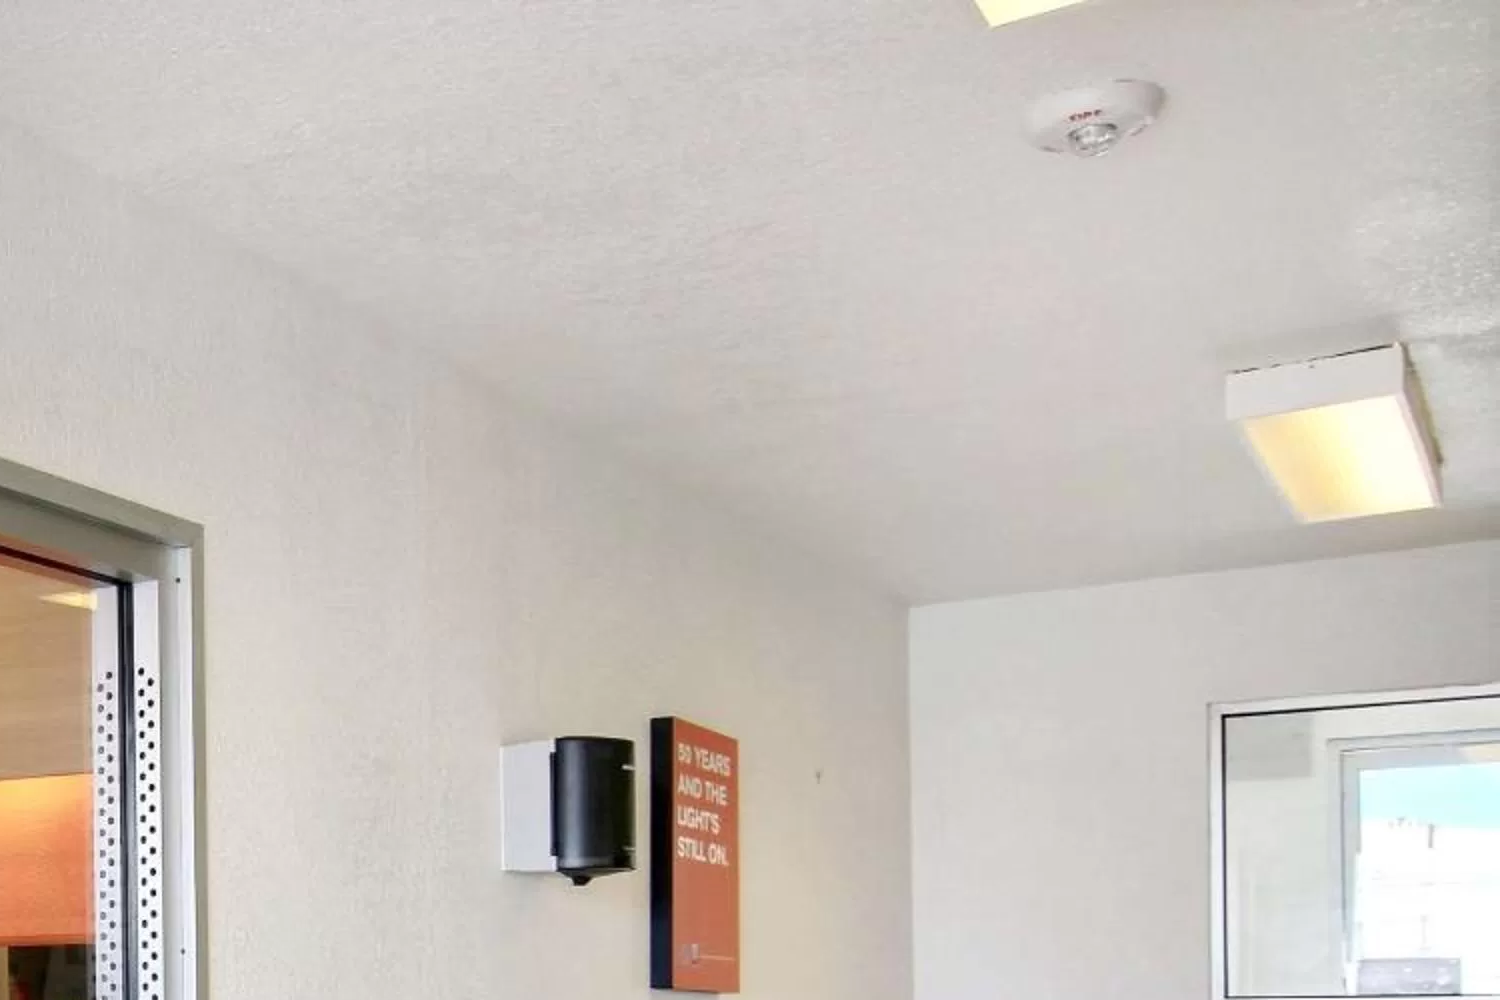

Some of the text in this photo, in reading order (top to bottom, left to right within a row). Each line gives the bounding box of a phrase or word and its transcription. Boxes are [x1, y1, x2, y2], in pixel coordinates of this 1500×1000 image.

[677, 742, 731, 777] 50 YEARS
[677, 773, 729, 807] AND THE
[676, 835, 706, 863] STILL
